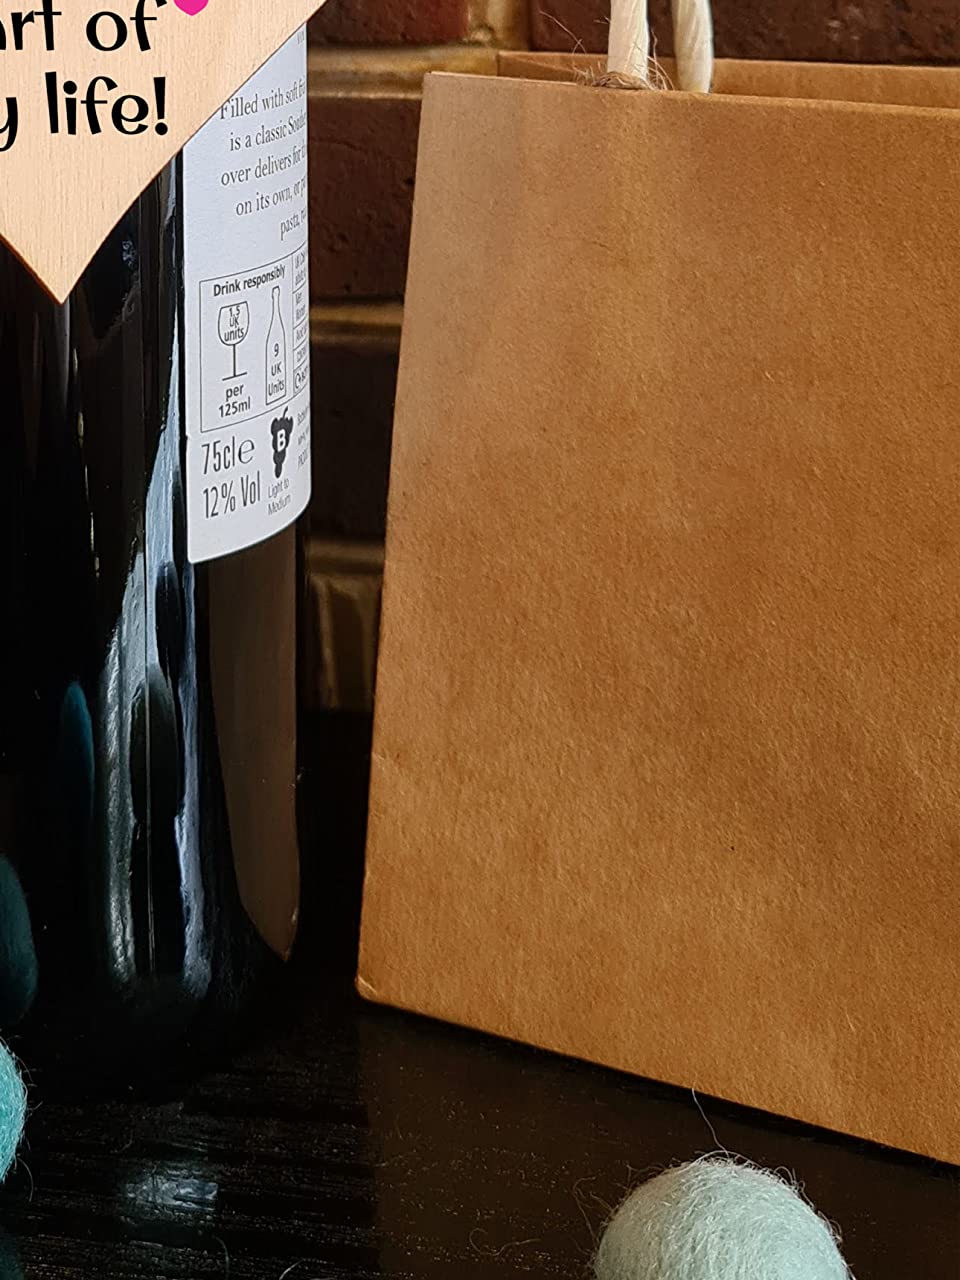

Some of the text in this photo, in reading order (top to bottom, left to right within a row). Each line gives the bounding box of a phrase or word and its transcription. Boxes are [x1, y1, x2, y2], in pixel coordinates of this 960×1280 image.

[45, 71, 169, 136] life!
[220, 93, 258, 119] Filled
[262, 87, 284, 111] with
[230, 131, 241, 151] is
[245, 135, 252, 148] a
[255, 120, 287, 146] classic
[221, 167, 251, 186] over
[254, 154, 292, 178] delivers
[236, 200, 252, 216] on
[256, 191, 270, 211] its
[272, 187, 293, 206] own,
[213, 279, 241, 297] Drink
[243, 264, 286, 289] responsibly
[229, 315, 239, 328] UK
[224, 327, 245, 342] units
[274, 342, 279, 358] 9
[271, 360, 282, 377] UK
[225, 383, 244, 402] per
[268, 379, 285, 397] Units
[218, 395, 251, 418] 125ml
[277, 428, 286, 452] B
[203, 470, 261, 519] 12% Vol
